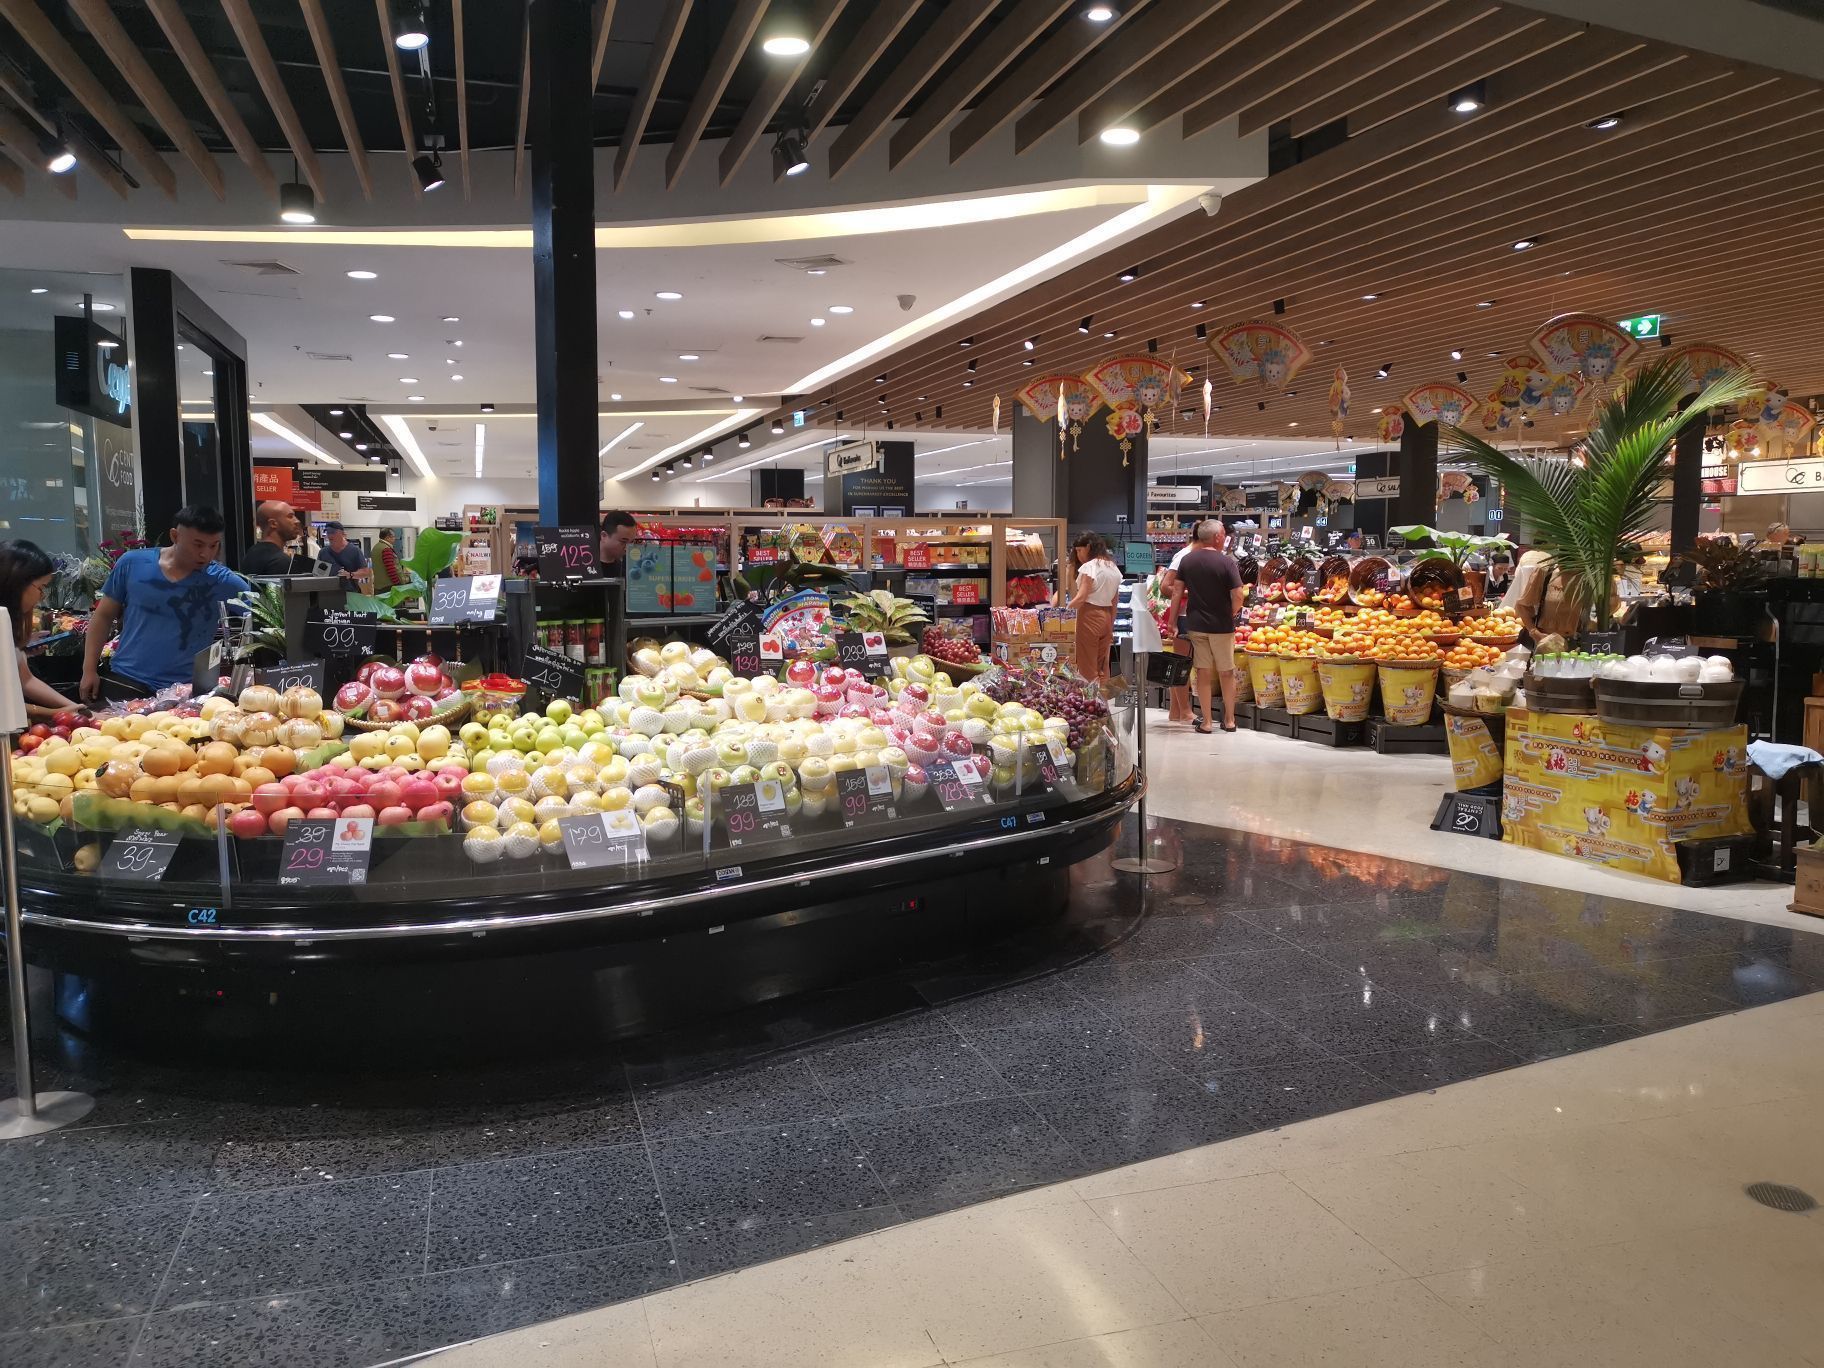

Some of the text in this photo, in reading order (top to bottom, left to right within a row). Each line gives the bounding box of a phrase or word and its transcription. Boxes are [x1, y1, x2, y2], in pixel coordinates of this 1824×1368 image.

[560, 545, 594, 568] 125
[435, 589, 467, 611] 399
[842, 645, 866, 662] 239
[735, 655, 760, 672] 139
[1560, 747, 1597, 759] CHINESE
[1598, 752, 1617, 761] NEW
[188, 908, 217, 923] C42
